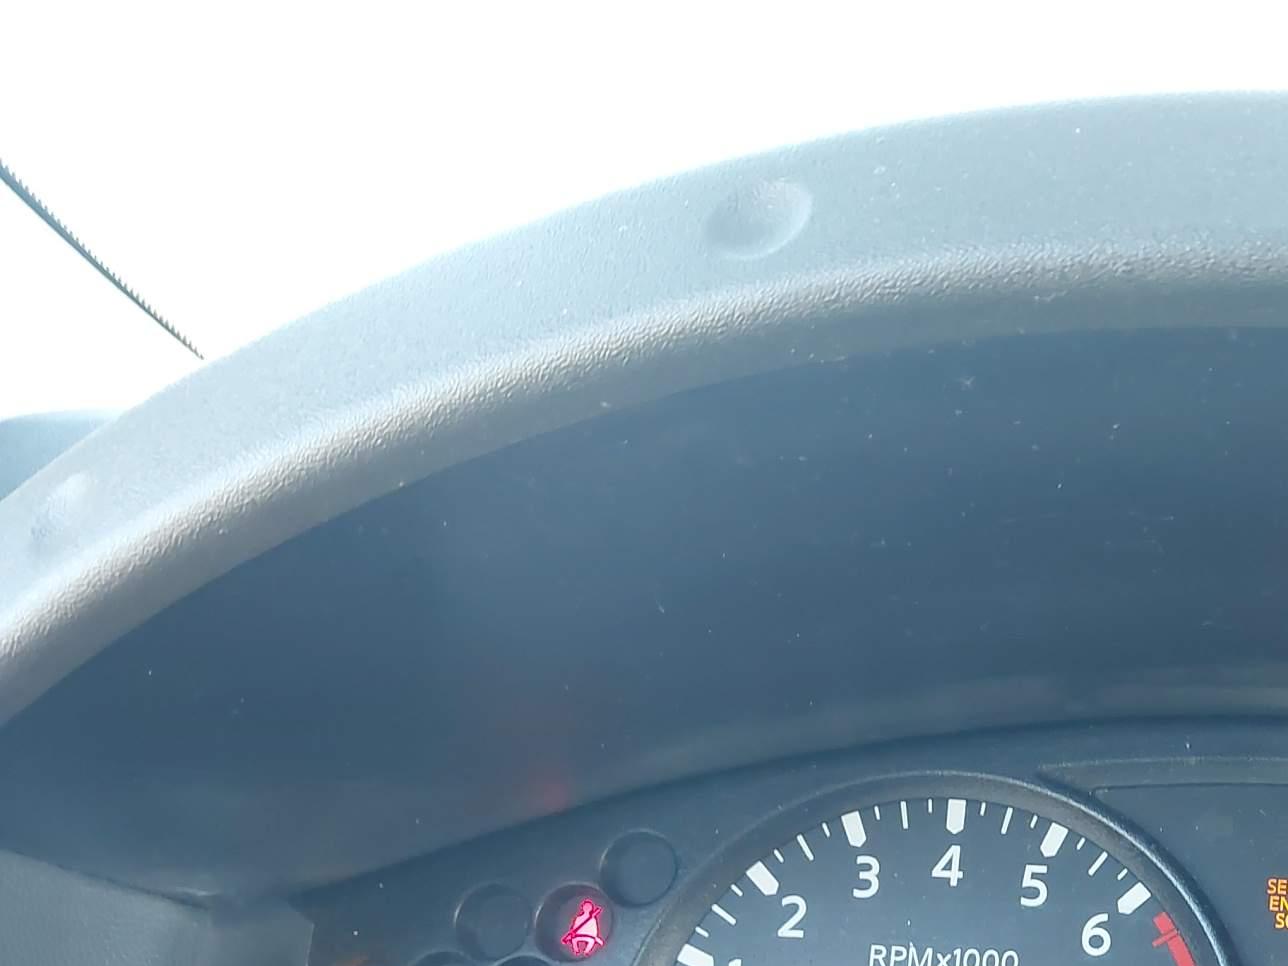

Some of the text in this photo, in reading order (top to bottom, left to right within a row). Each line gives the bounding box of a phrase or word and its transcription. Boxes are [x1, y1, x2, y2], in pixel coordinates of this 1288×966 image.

[852, 855, 881, 899] 3
[932, 844, 965, 887] 4
[1020, 864, 1048, 907] 5
[777, 895, 807, 938] 2
[1080, 913, 1112, 956] 6
